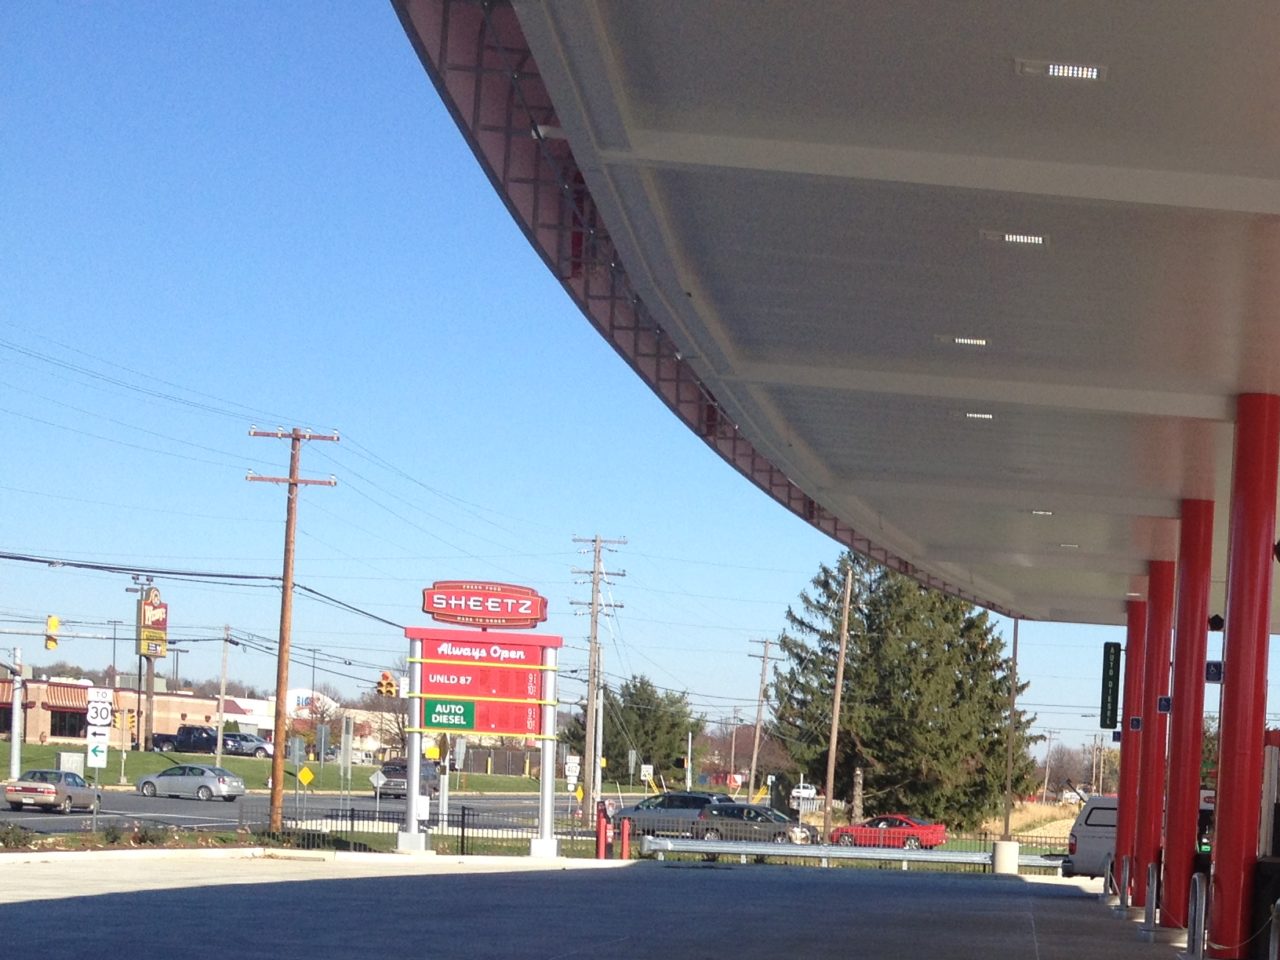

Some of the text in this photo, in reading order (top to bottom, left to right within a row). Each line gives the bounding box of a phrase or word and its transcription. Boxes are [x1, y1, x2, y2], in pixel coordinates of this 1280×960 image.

[432, 594, 532, 614] SHEETZ
[437, 642, 525, 660] Always Open
[429, 674, 472, 685] UNLD 87
[96, 691, 107, 699] TO
[90, 706, 109, 720] 30
[435, 704, 464, 714] AUTO
[431, 714, 467, 725] DIESEL
